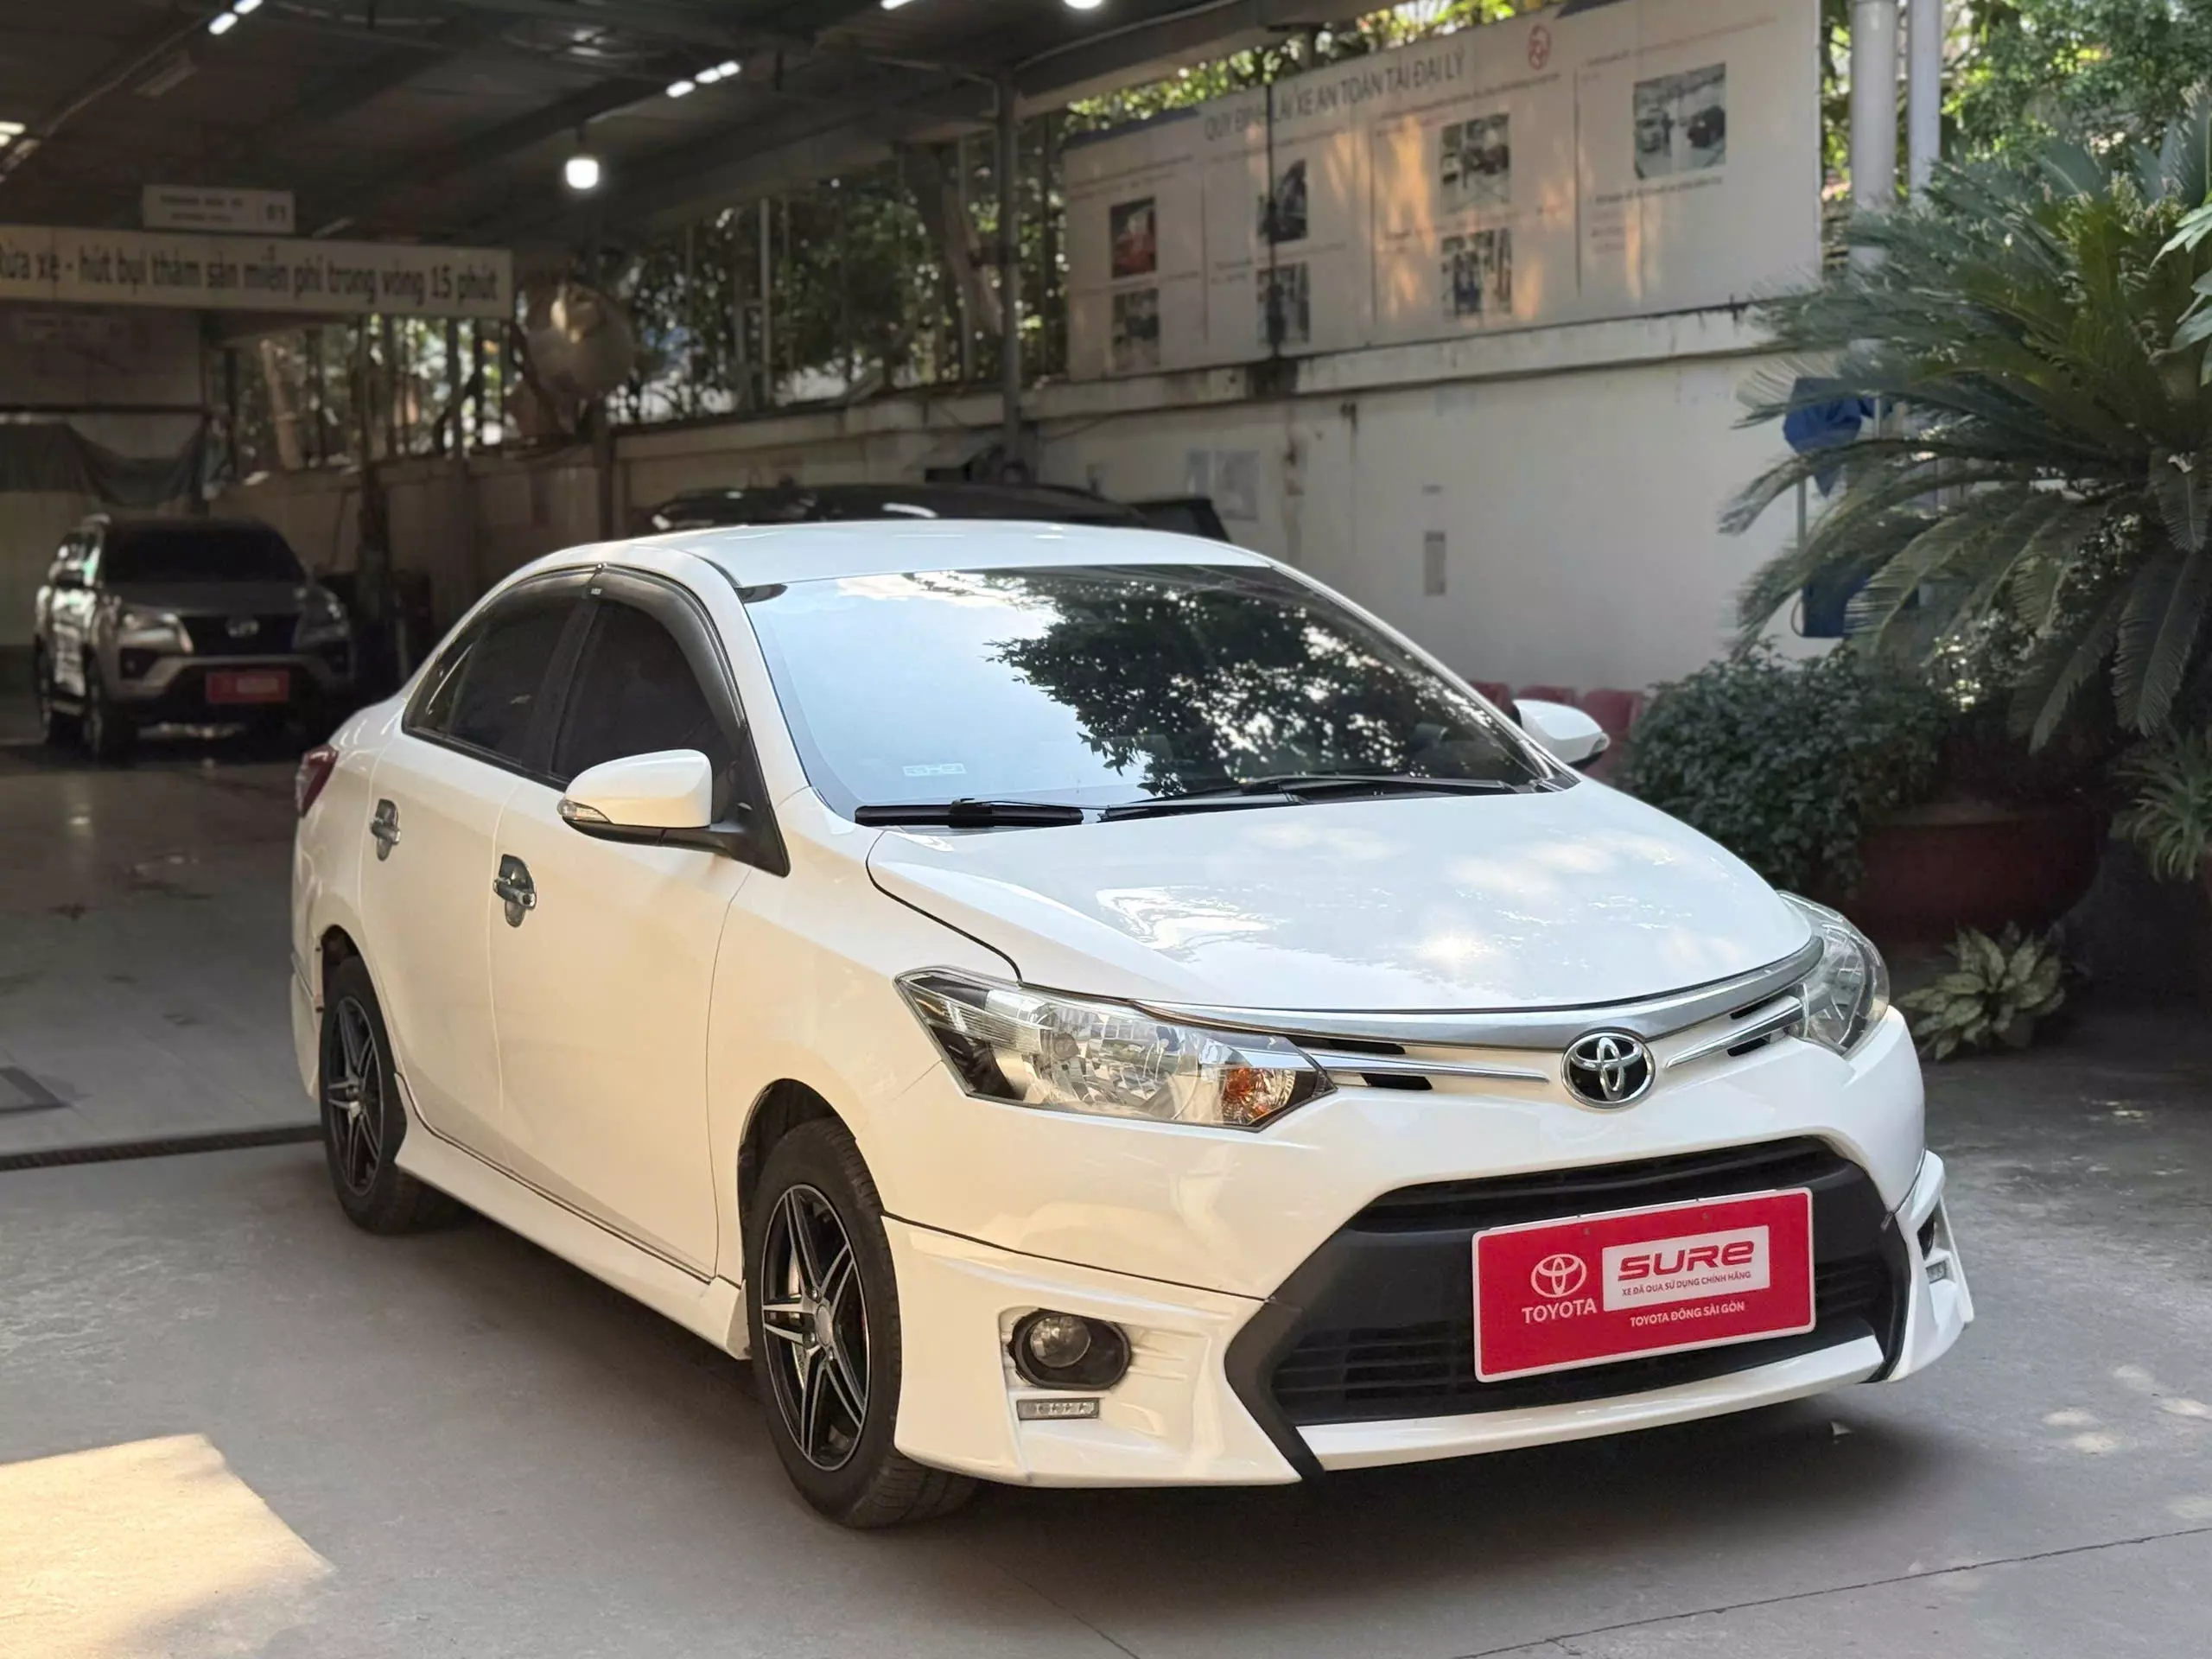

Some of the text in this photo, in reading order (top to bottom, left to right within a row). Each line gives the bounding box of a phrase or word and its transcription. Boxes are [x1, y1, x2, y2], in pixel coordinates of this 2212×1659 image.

[328, 259, 377, 305] trong
[431, 263, 452, 300] 15
[1622, 1287, 1632, 1296] XE
[1632, 1282, 1645, 1295] ĐÃ
[1645, 1282, 1664, 1294] QUA
[1676, 1279, 1700, 1290] DỤNG
[1701, 1274, 1726, 1285] CHÍNH
[1727, 1270, 1751, 1281] HÃNG
[1522, 1298, 1597, 1324] TOYOTA
[1630, 1299, 1745, 1327] TOYOTA ĐÔNG SÀI GÒN
